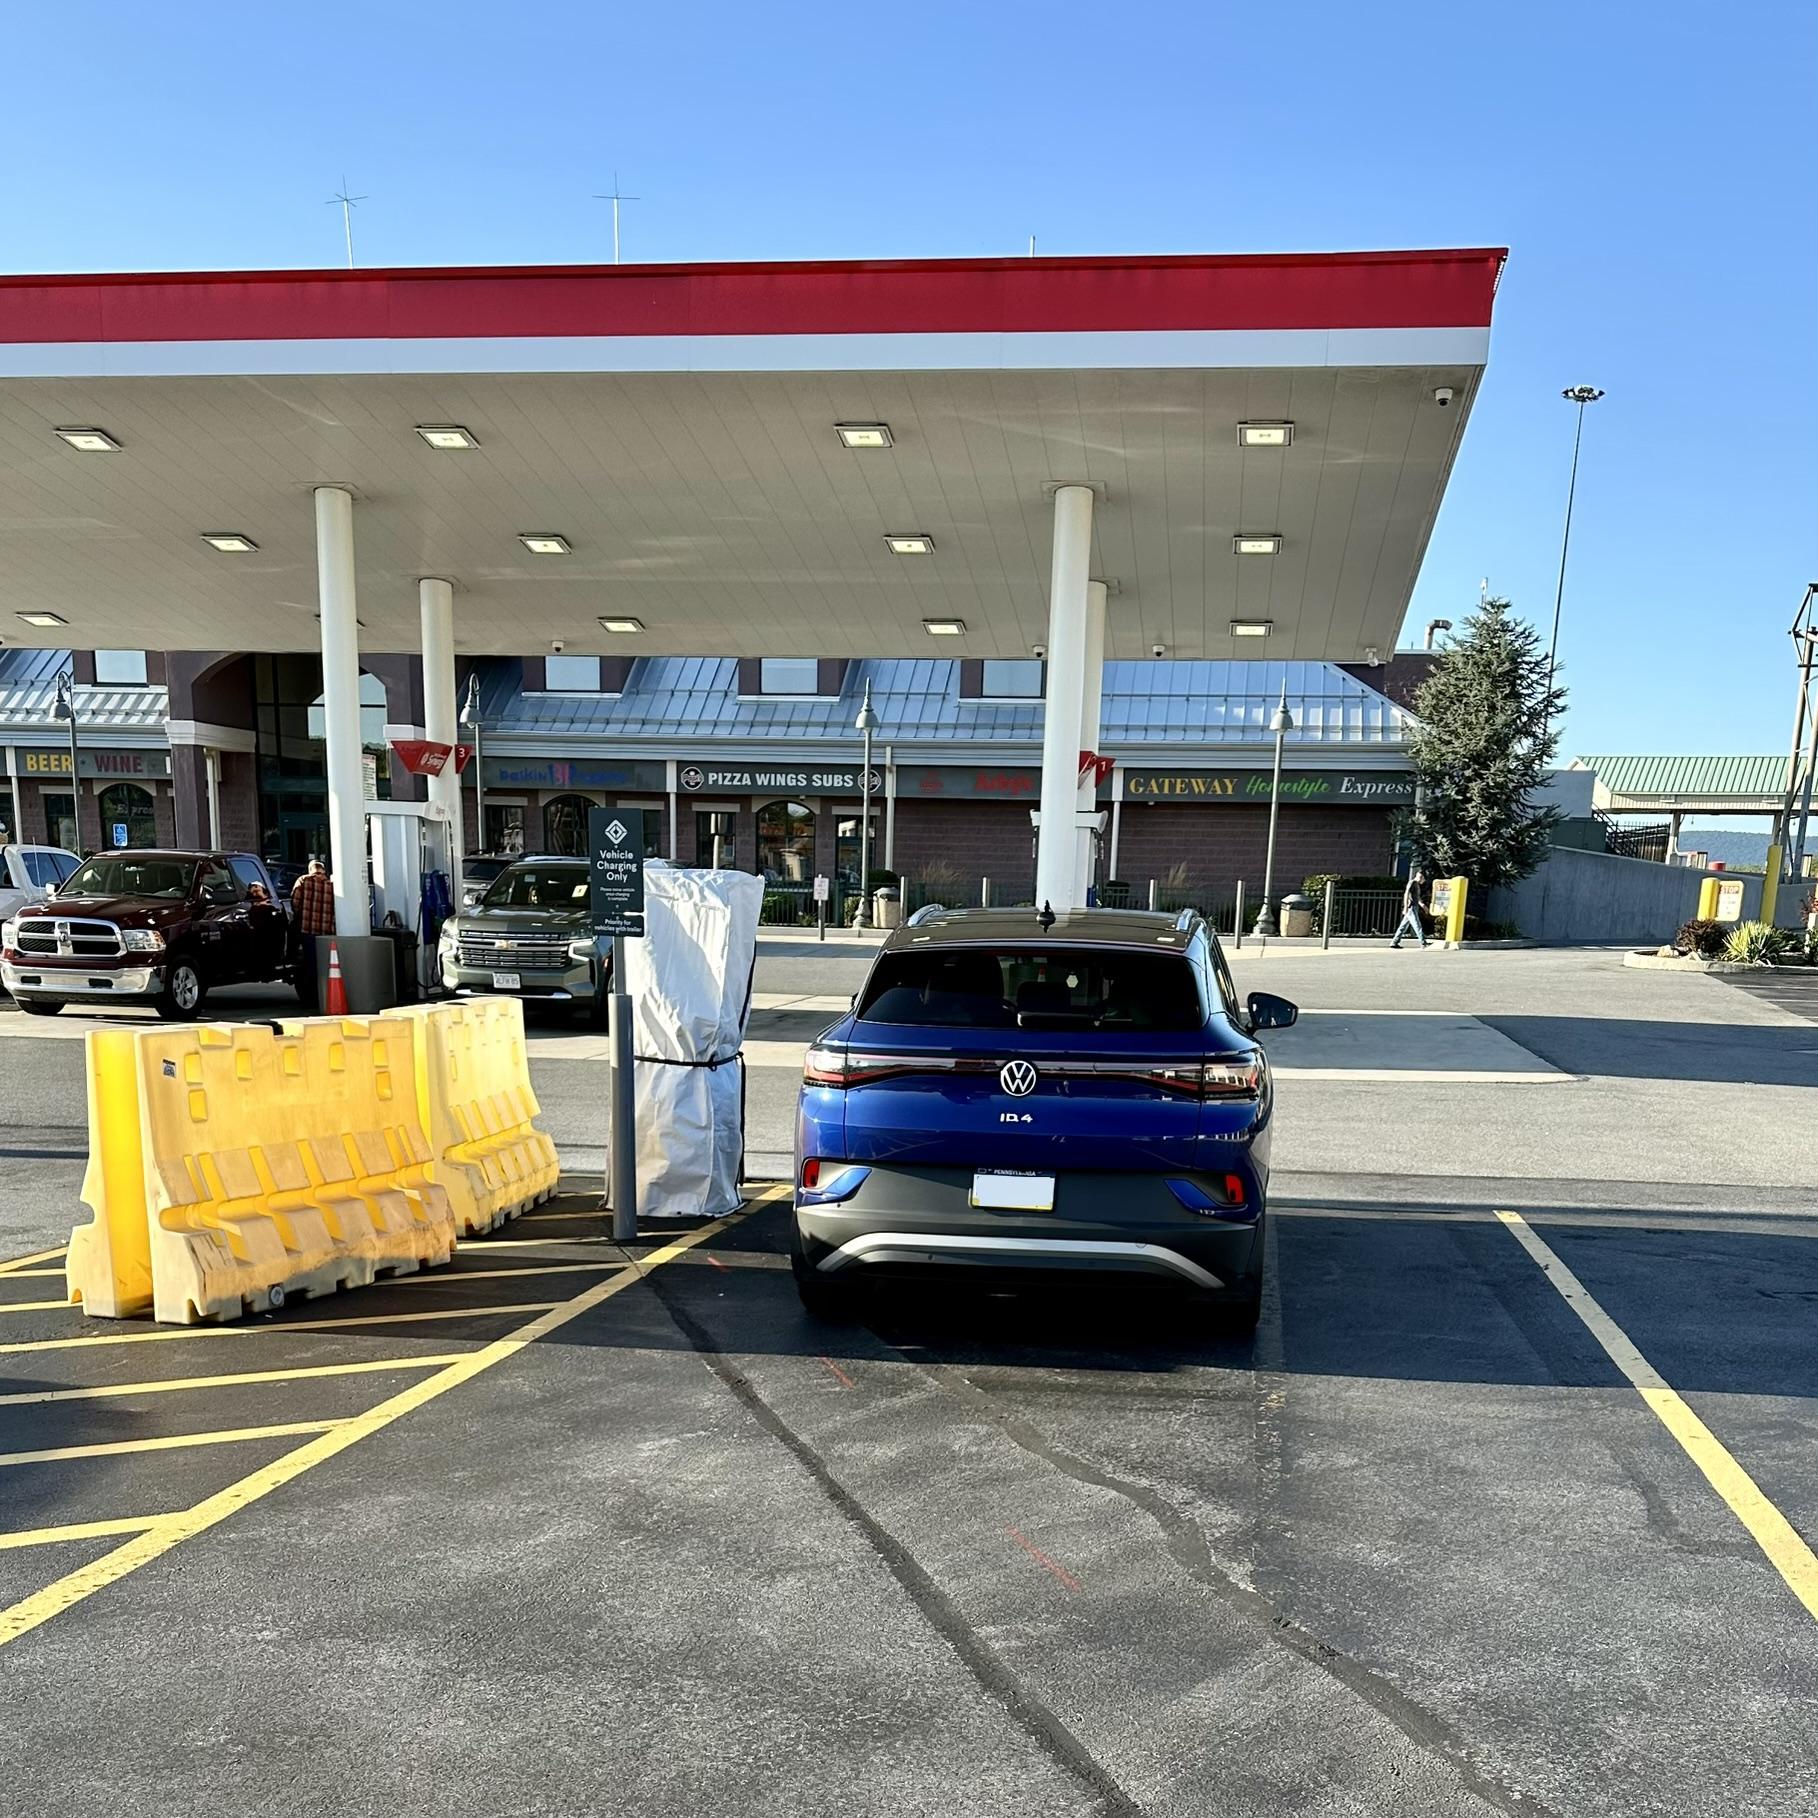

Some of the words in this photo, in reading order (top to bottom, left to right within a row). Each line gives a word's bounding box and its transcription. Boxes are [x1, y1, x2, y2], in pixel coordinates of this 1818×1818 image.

[458, 747, 465, 758] 3
[26, 754, 73, 772] BEER
[95, 755, 144, 773] WINE
[1101, 761, 1106, 771] 1
[708, 773, 751, 786] PIZZA
[755, 773, 808, 787] WINGS
[811, 774, 854, 787] SUBS
[1128, 777, 1239, 795] GATEWAY
[1340, 776, 1413, 798] Express
[600, 850, 634, 859] Vehicle
[596, 860, 638, 873] Charging
[606, 871, 628, 883] Only
